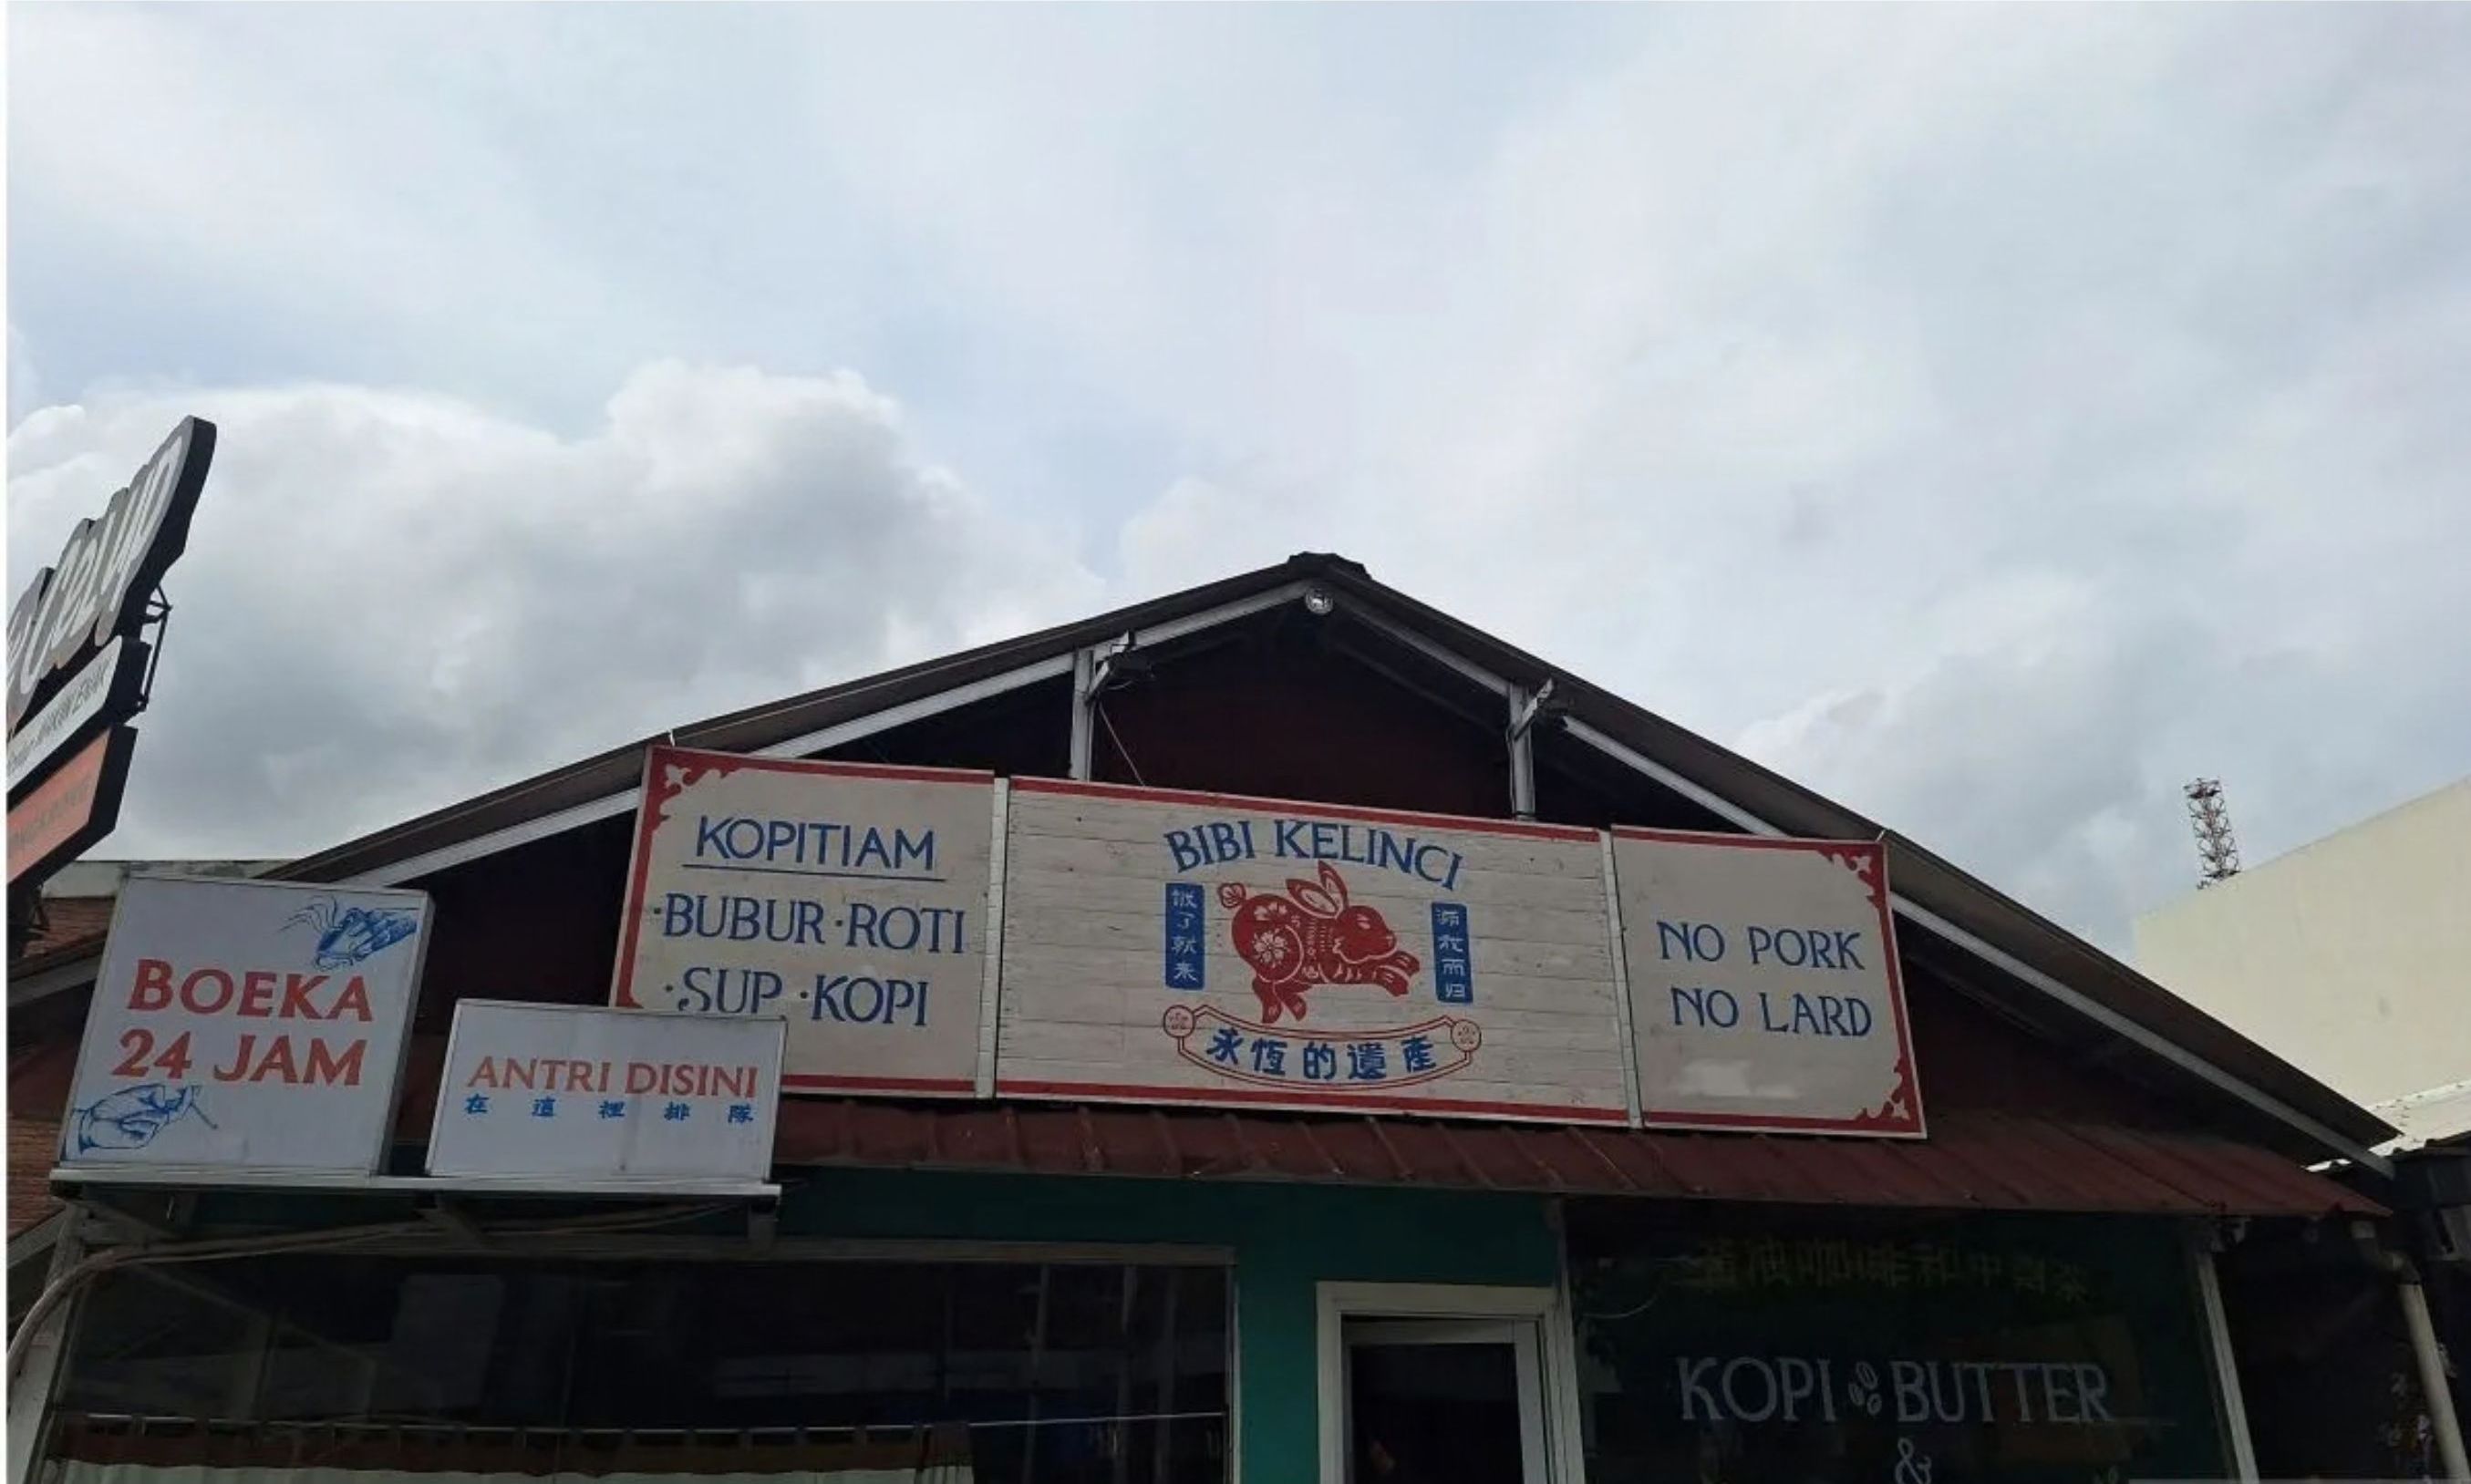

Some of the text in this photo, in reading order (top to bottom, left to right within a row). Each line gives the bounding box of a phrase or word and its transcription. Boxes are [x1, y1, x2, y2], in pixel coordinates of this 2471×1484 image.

[696, 816, 935, 871] KOPITIAM
[1163, 819, 1463, 891] BIBI KELINCI
[663, 893, 965, 953] BUBUR ROTI
[1657, 921, 1865, 970] NO PORK
[127, 958, 373, 1022] BOEKA
[678, 967, 928, 1026] SUP KOPI
[1670, 987, 1872, 1037] NO LARD
[110, 1028, 368, 1087] 24 JAM
[467, 1056, 759, 1098] ANTRI DISINI
[1677, 1356, 2116, 1424] KOPI BUTTER
[1895, 1438, 1932, 1484] &
